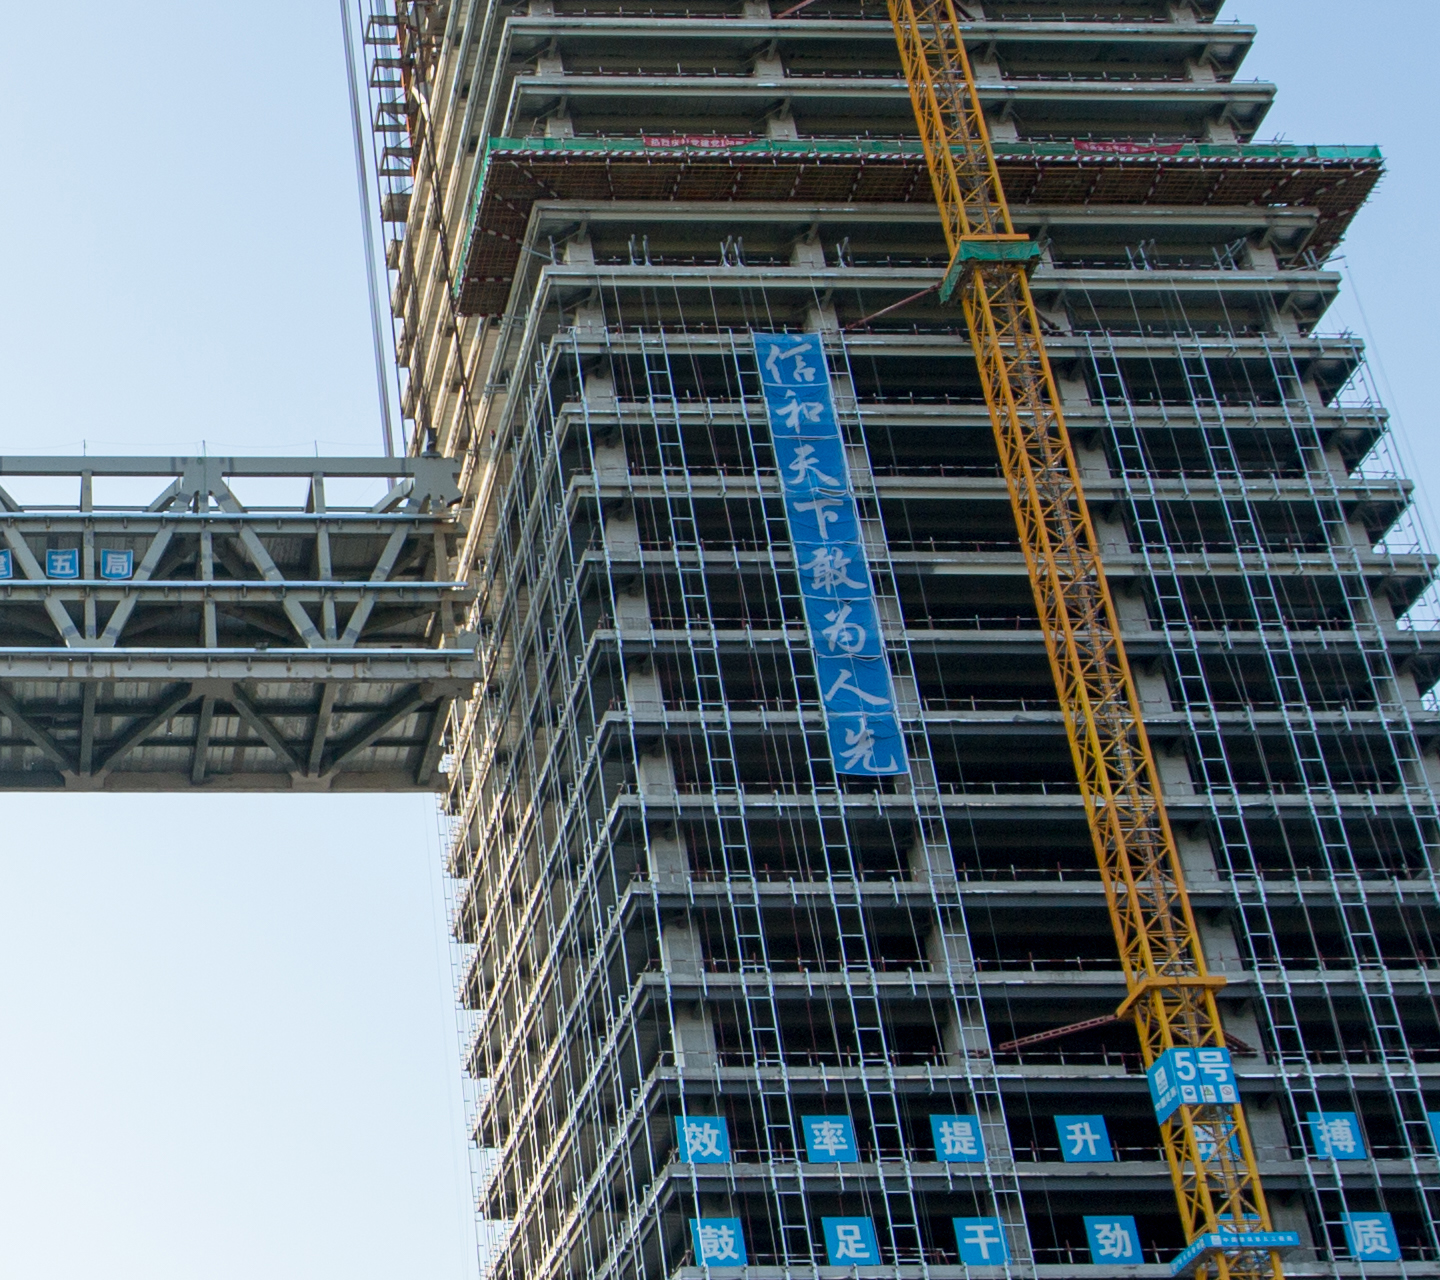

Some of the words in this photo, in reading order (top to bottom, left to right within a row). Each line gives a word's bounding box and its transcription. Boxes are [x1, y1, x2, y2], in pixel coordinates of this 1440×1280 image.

[766, 336, 899, 774] 信和天下敢为人先
[1174, 1051, 1230, 1082] 5号
